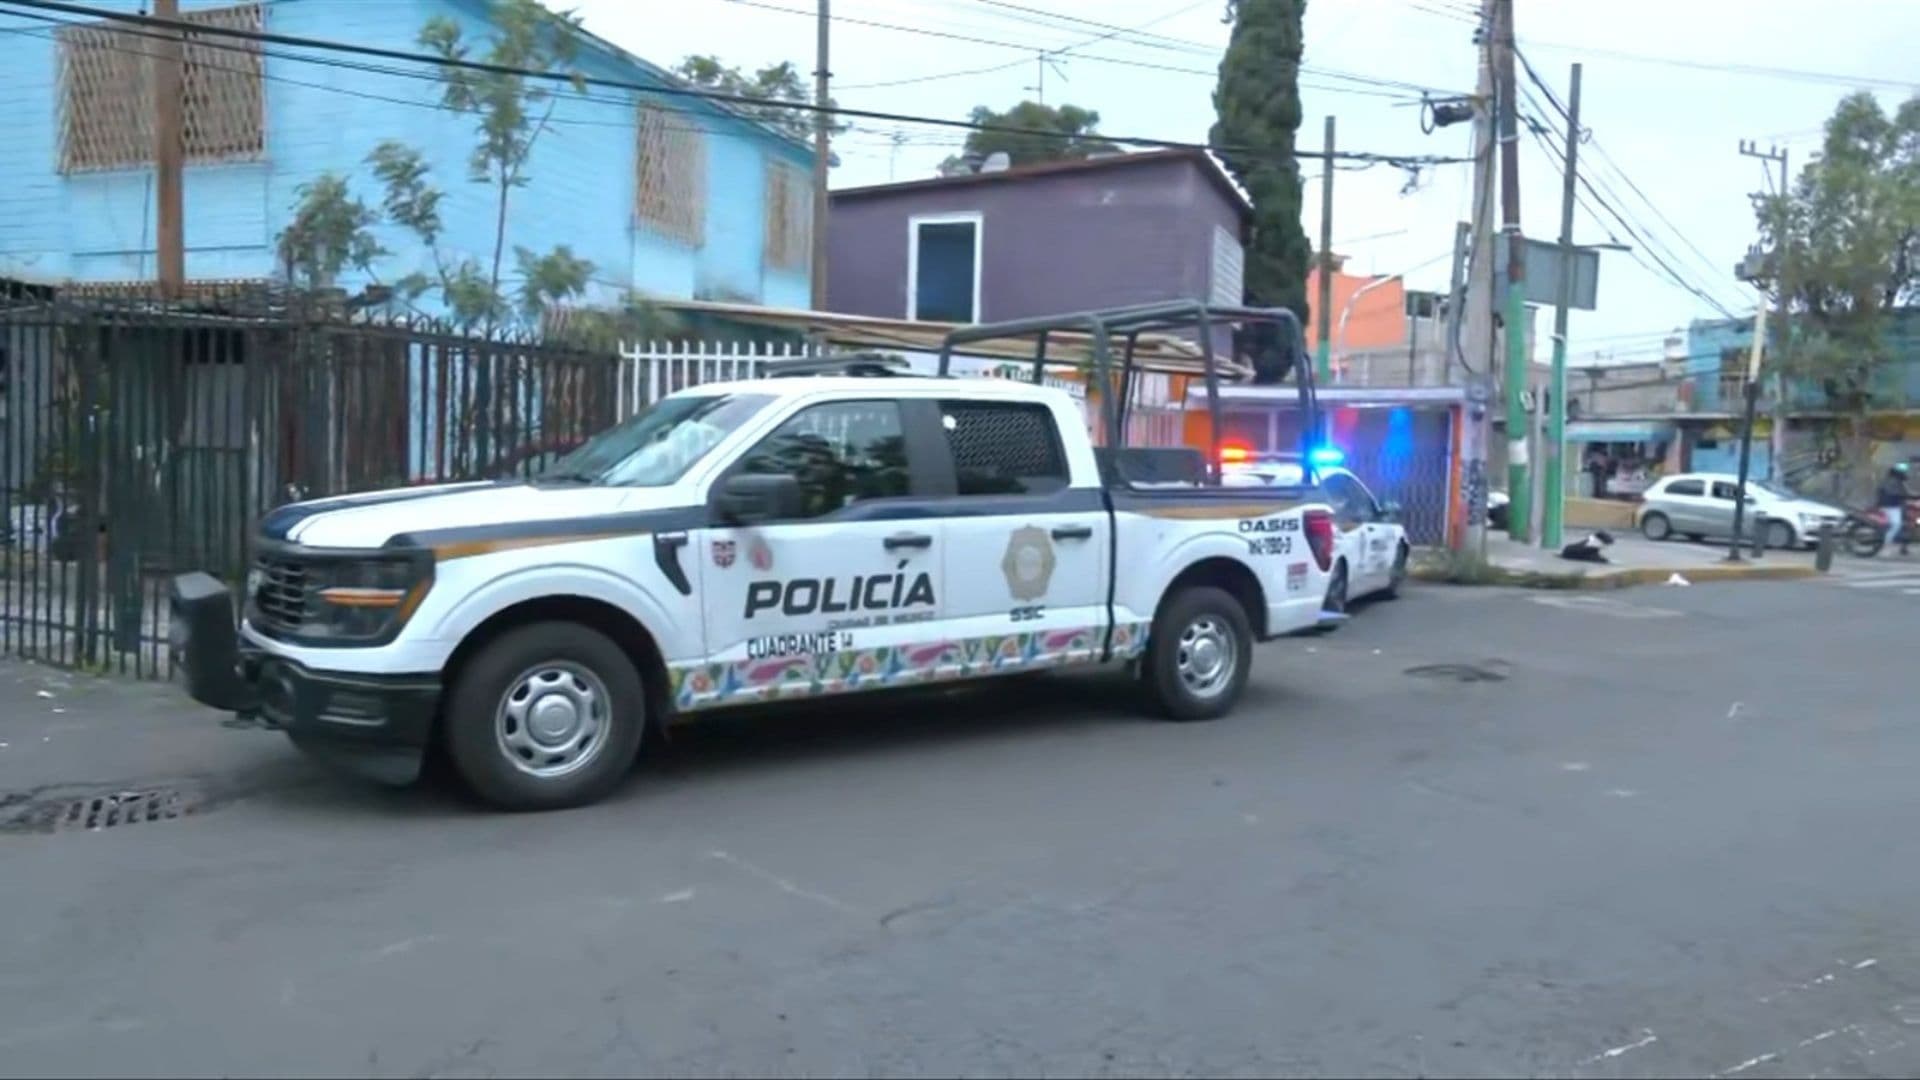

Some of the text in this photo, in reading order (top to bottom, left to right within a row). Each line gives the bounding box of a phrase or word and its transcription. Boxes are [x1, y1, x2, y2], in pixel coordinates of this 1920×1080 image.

[1239, 518, 1299, 533] OASIS
[744, 559, 936, 619] POLICÍA
[1010, 605, 1046, 622] SSC
[747, 632, 836, 659] CUADRANTE
